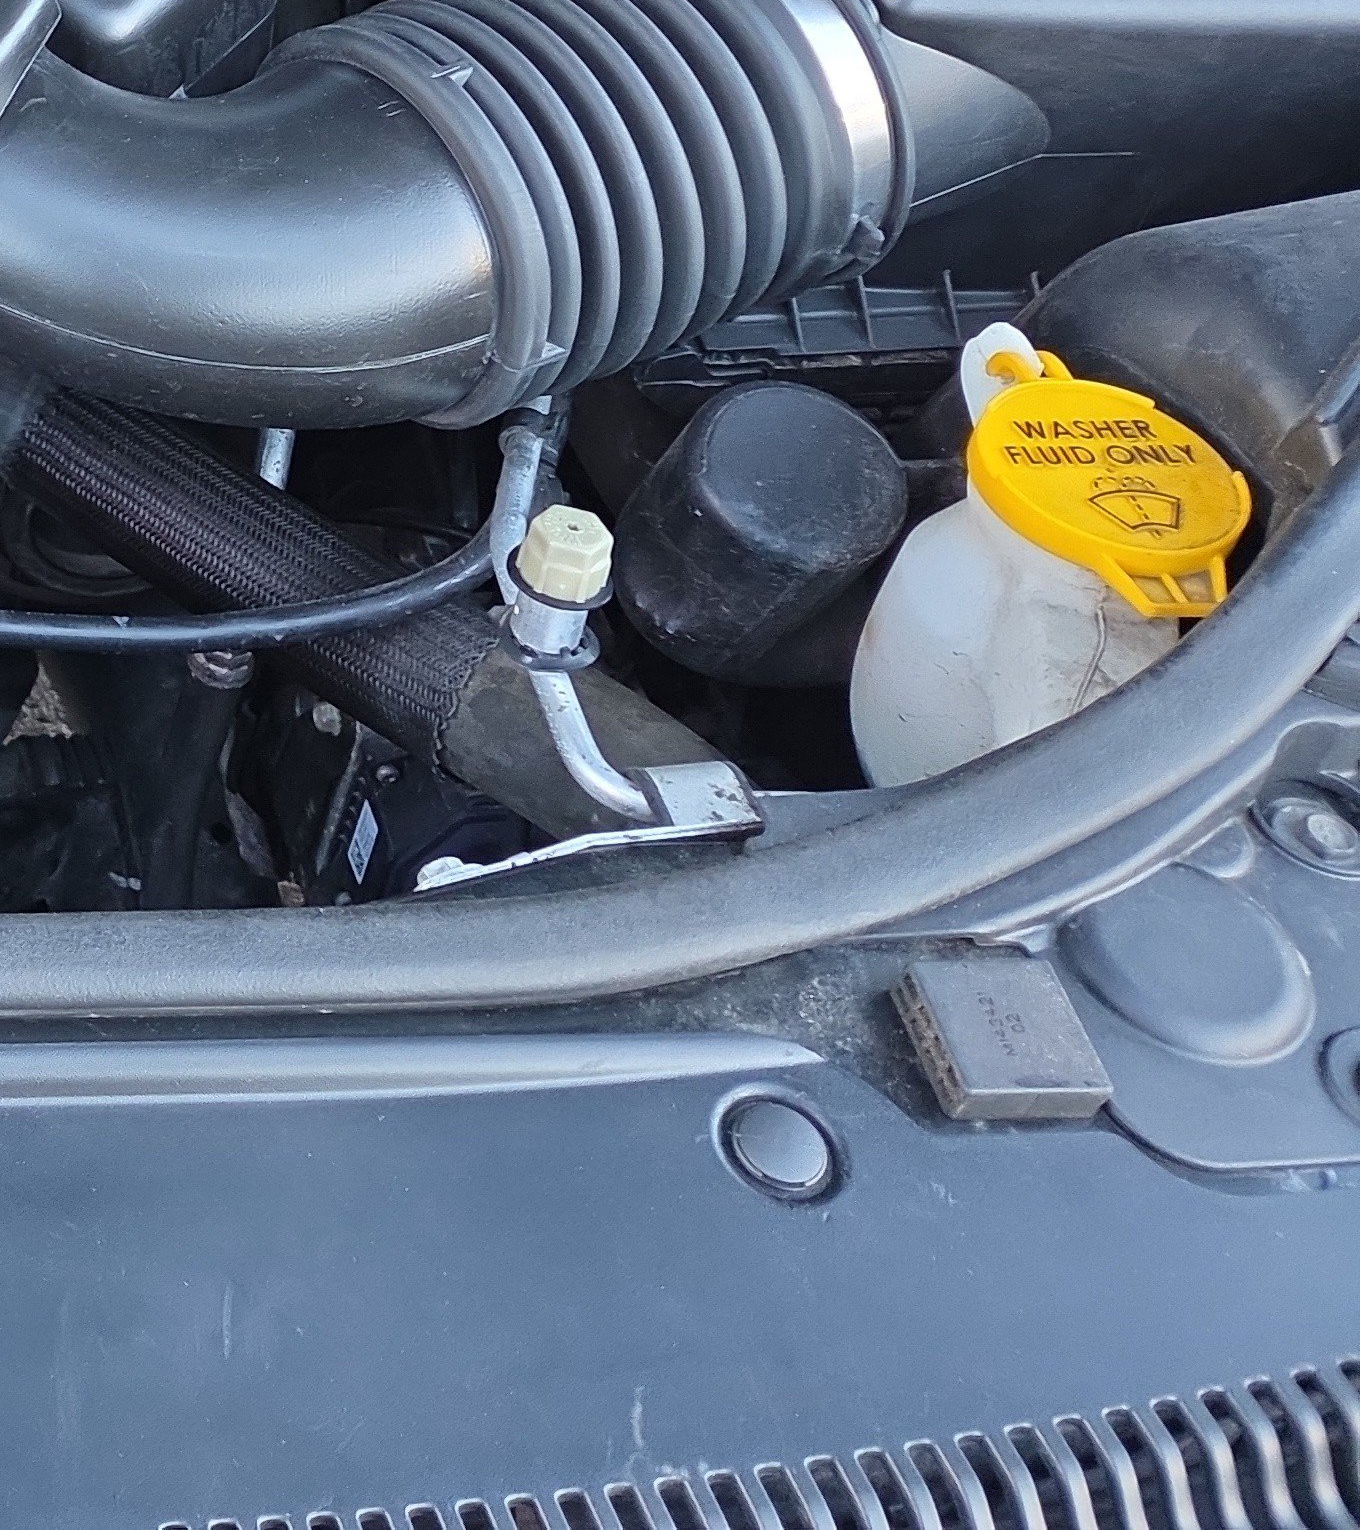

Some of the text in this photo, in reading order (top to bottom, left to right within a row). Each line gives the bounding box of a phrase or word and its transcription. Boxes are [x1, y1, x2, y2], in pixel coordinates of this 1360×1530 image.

[1012, 419, 1158, 440] WASHER
[1004, 444, 1197, 465] FLUID ONLY
